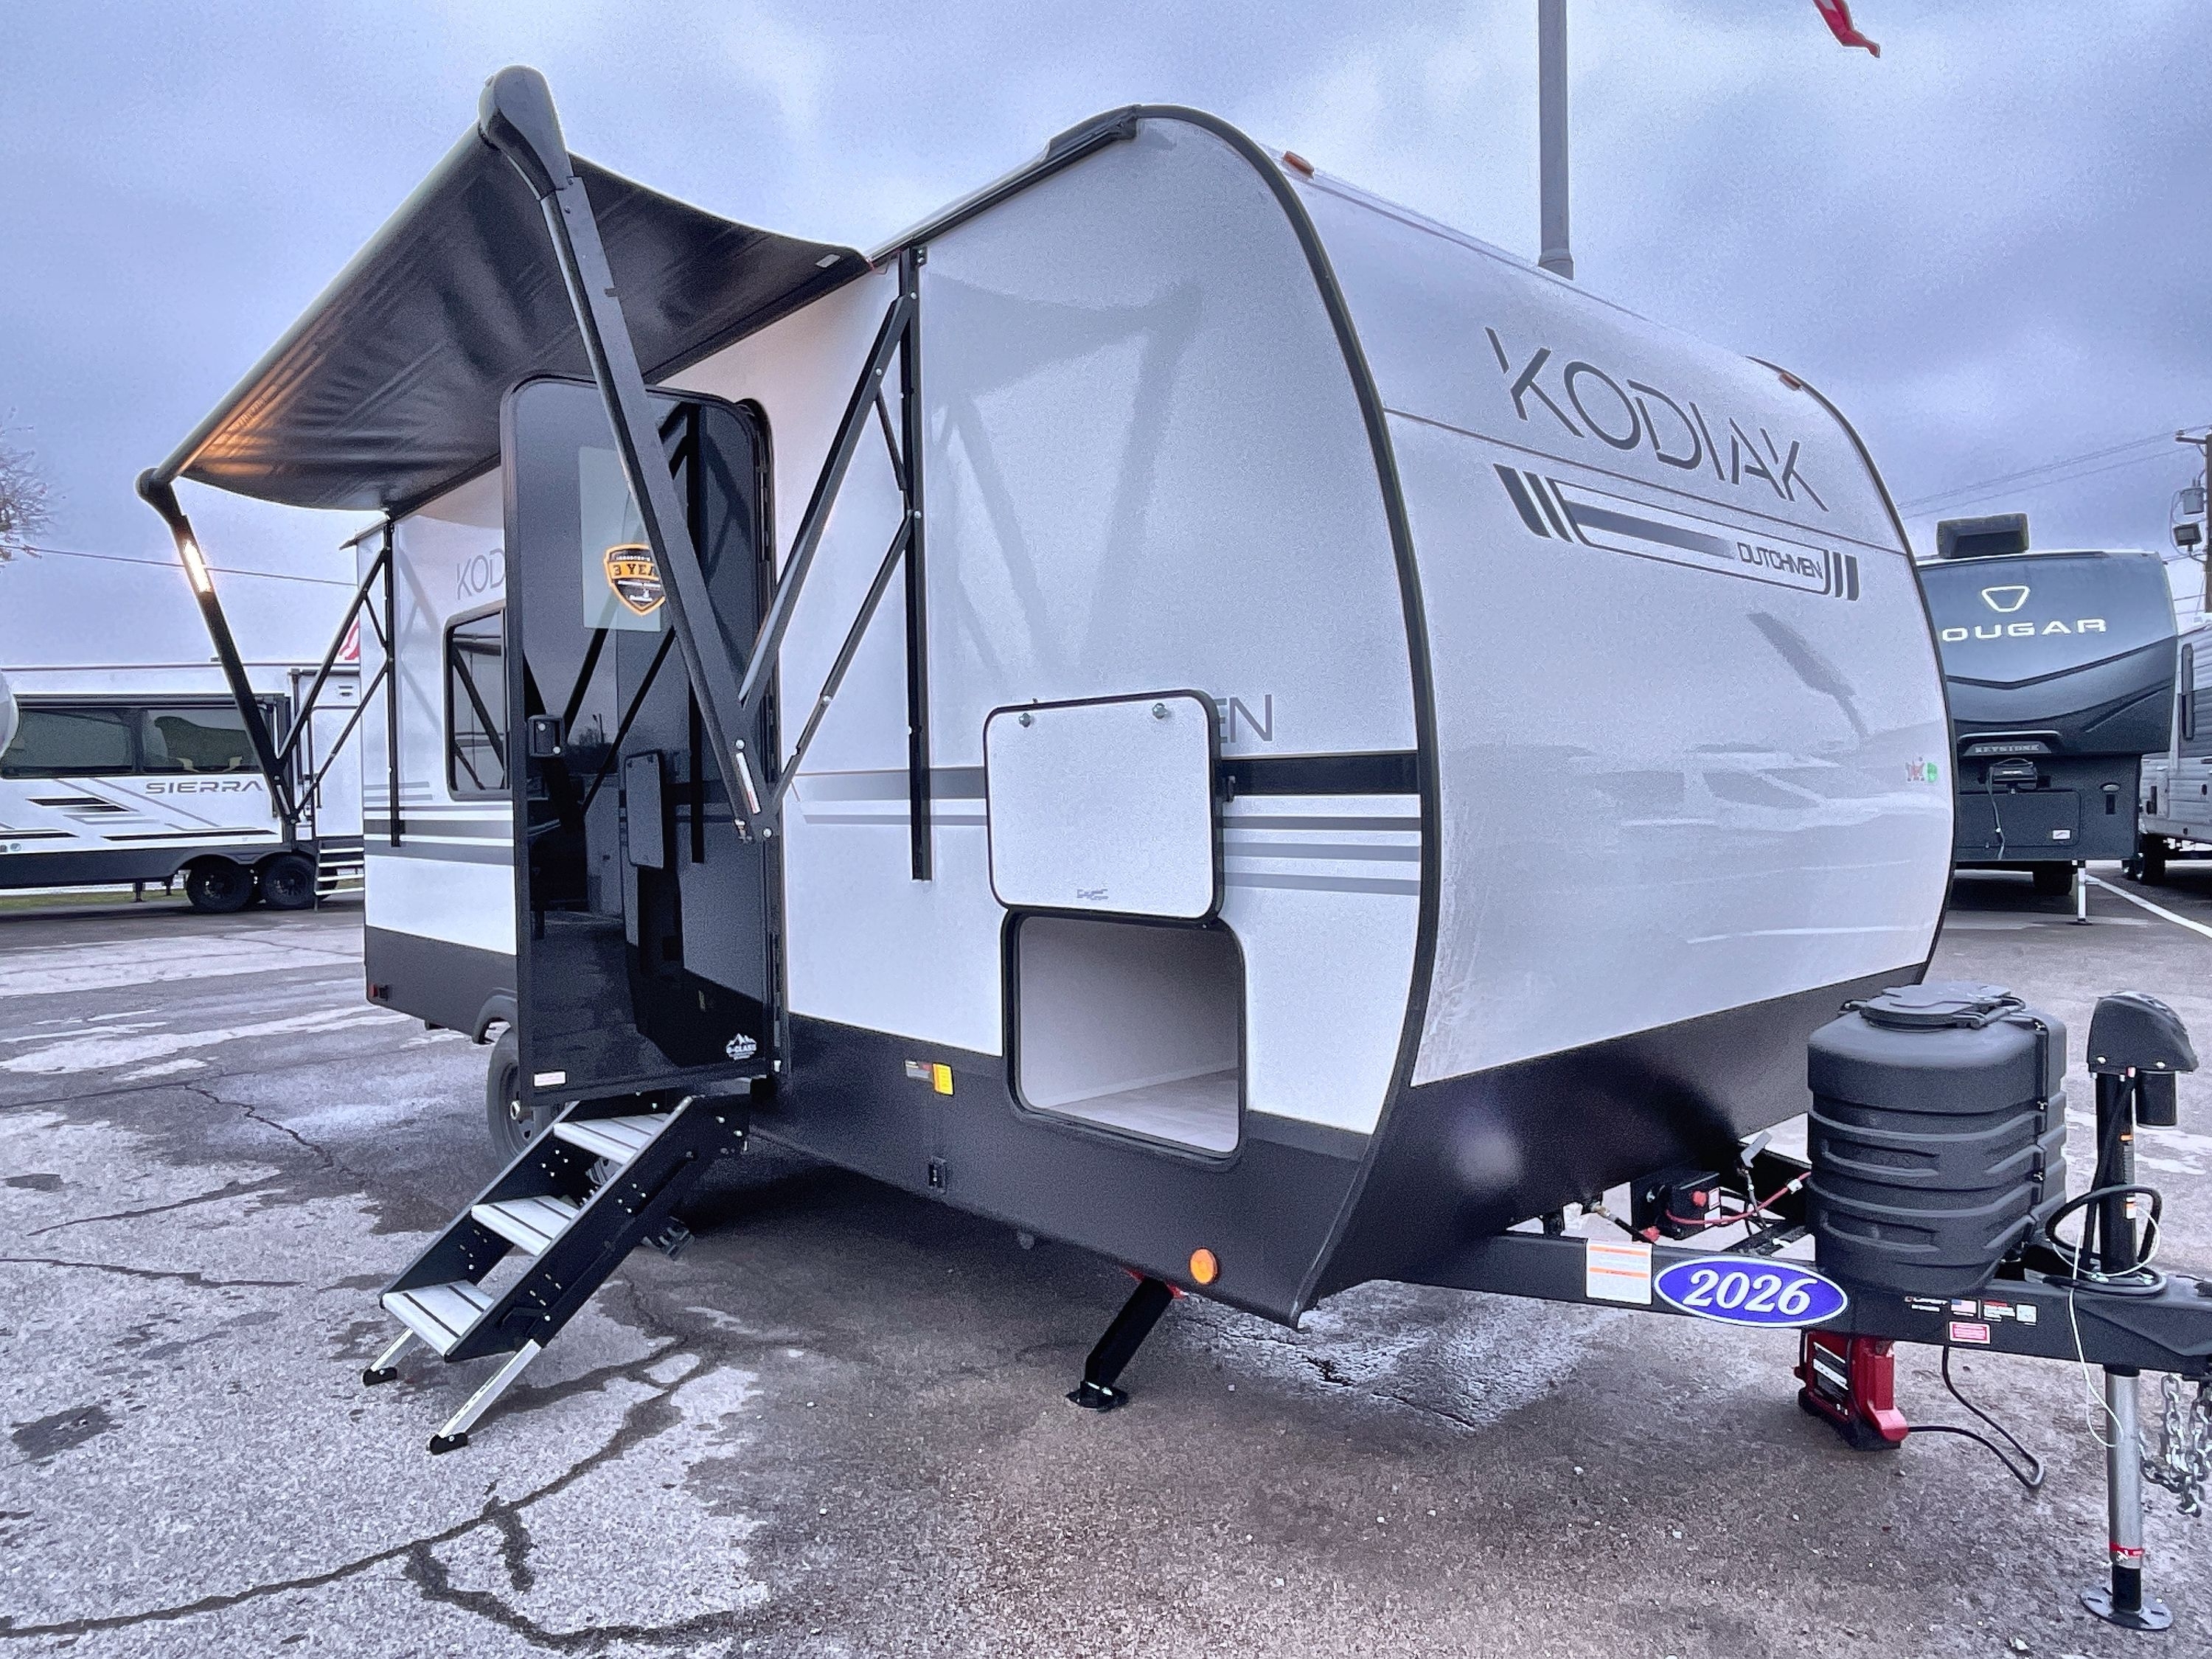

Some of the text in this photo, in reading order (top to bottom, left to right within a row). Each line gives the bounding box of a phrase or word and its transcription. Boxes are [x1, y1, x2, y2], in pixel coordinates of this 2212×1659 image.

[1484, 326, 1830, 512] KODIAK
[1736, 541, 1823, 580] DUTCHMEN
[1941, 619, 2107, 642] OUGAR
[1975, 743, 2041, 754] KEYSTONE
[145, 780, 263, 795] SIERRA
[1682, 1269, 1818, 1316] 2026
